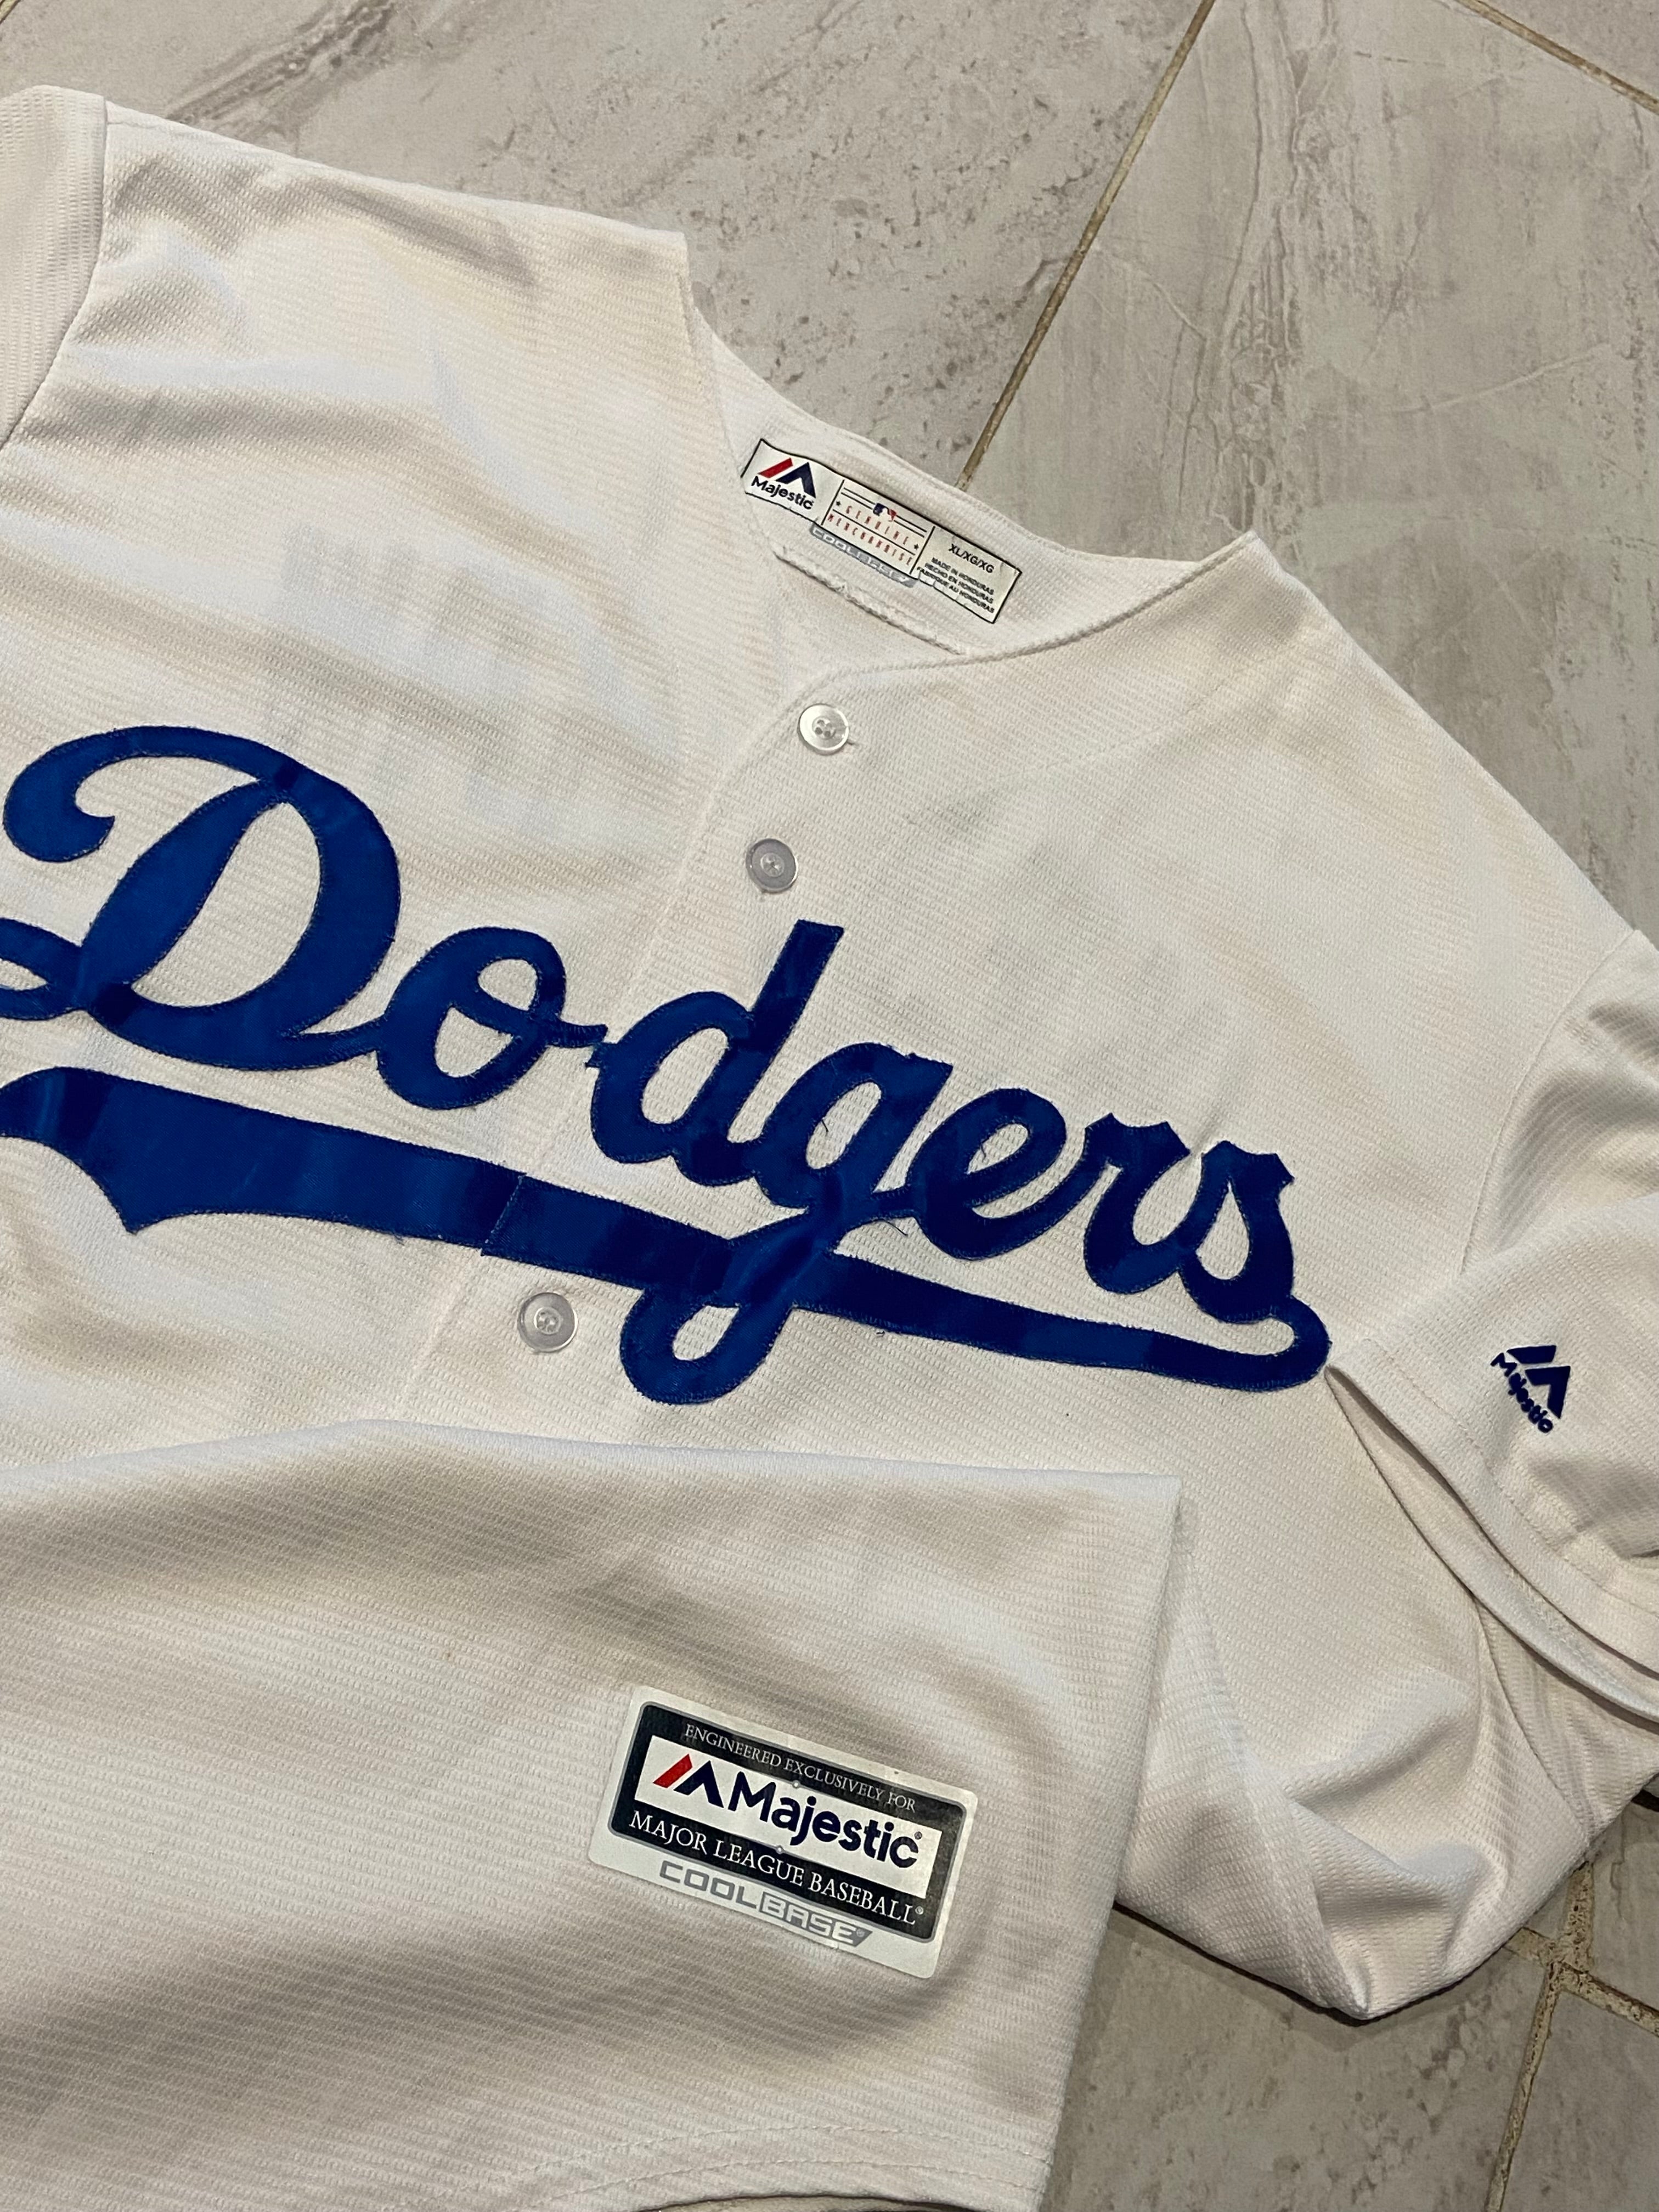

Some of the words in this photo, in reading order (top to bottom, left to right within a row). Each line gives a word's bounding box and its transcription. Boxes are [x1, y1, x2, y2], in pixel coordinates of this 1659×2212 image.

[751, 476, 813, 509] Majestic
[827, 514, 913, 566] MERCHANDISE
[846, 505, 909, 545] GENUINE
[932, 557, 951, 571] MADE
[958, 572, 994, 595] HONDURAS
[948, 543, 994, 573] XL/XG/XG
[0, 725, 1331, 1406] Dodgers
[685, 1723, 781, 1768] ENGINEERED
[784, 1759, 884, 1802] EXCLUSIVELY
[888, 1791, 916, 1812] FOR
[629, 1810, 707, 1855] MAJOR
[713, 1840, 805, 1887] LEAGUE
[727, 1771, 919, 1868] Majestic
[659, 1860, 857, 1946] COOLBASE
